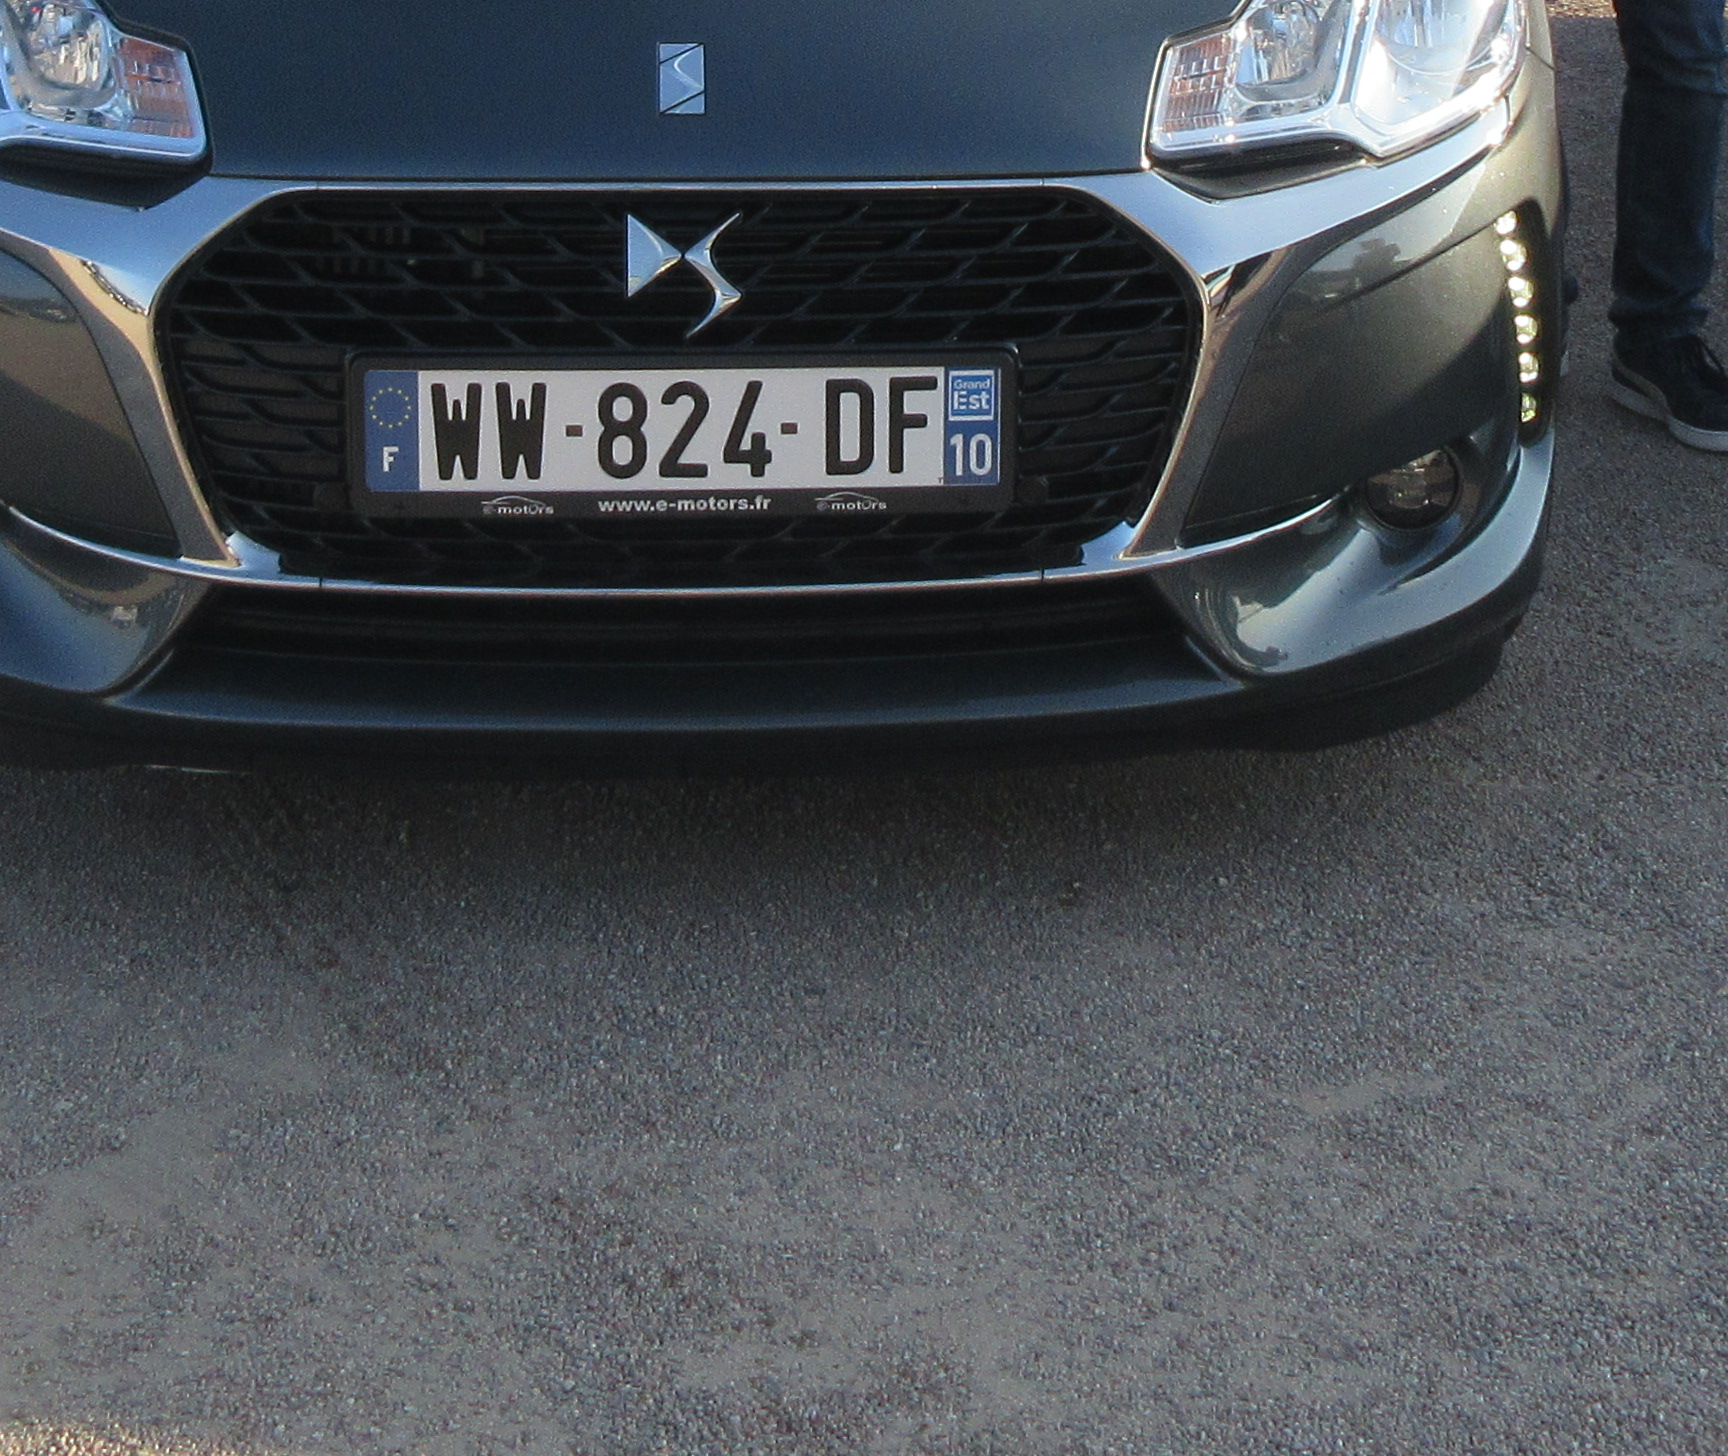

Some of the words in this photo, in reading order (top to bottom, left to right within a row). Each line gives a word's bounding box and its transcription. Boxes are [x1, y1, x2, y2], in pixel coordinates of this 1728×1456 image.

[953, 378, 991, 390] Grand
[953, 390, 990, 410] Est
[430, 375, 939, 480] WW-824-DF
[381, 446, 399, 473] F
[950, 433, 992, 476] 10
[597, 494, 772, 513] www.e-motors.fr
